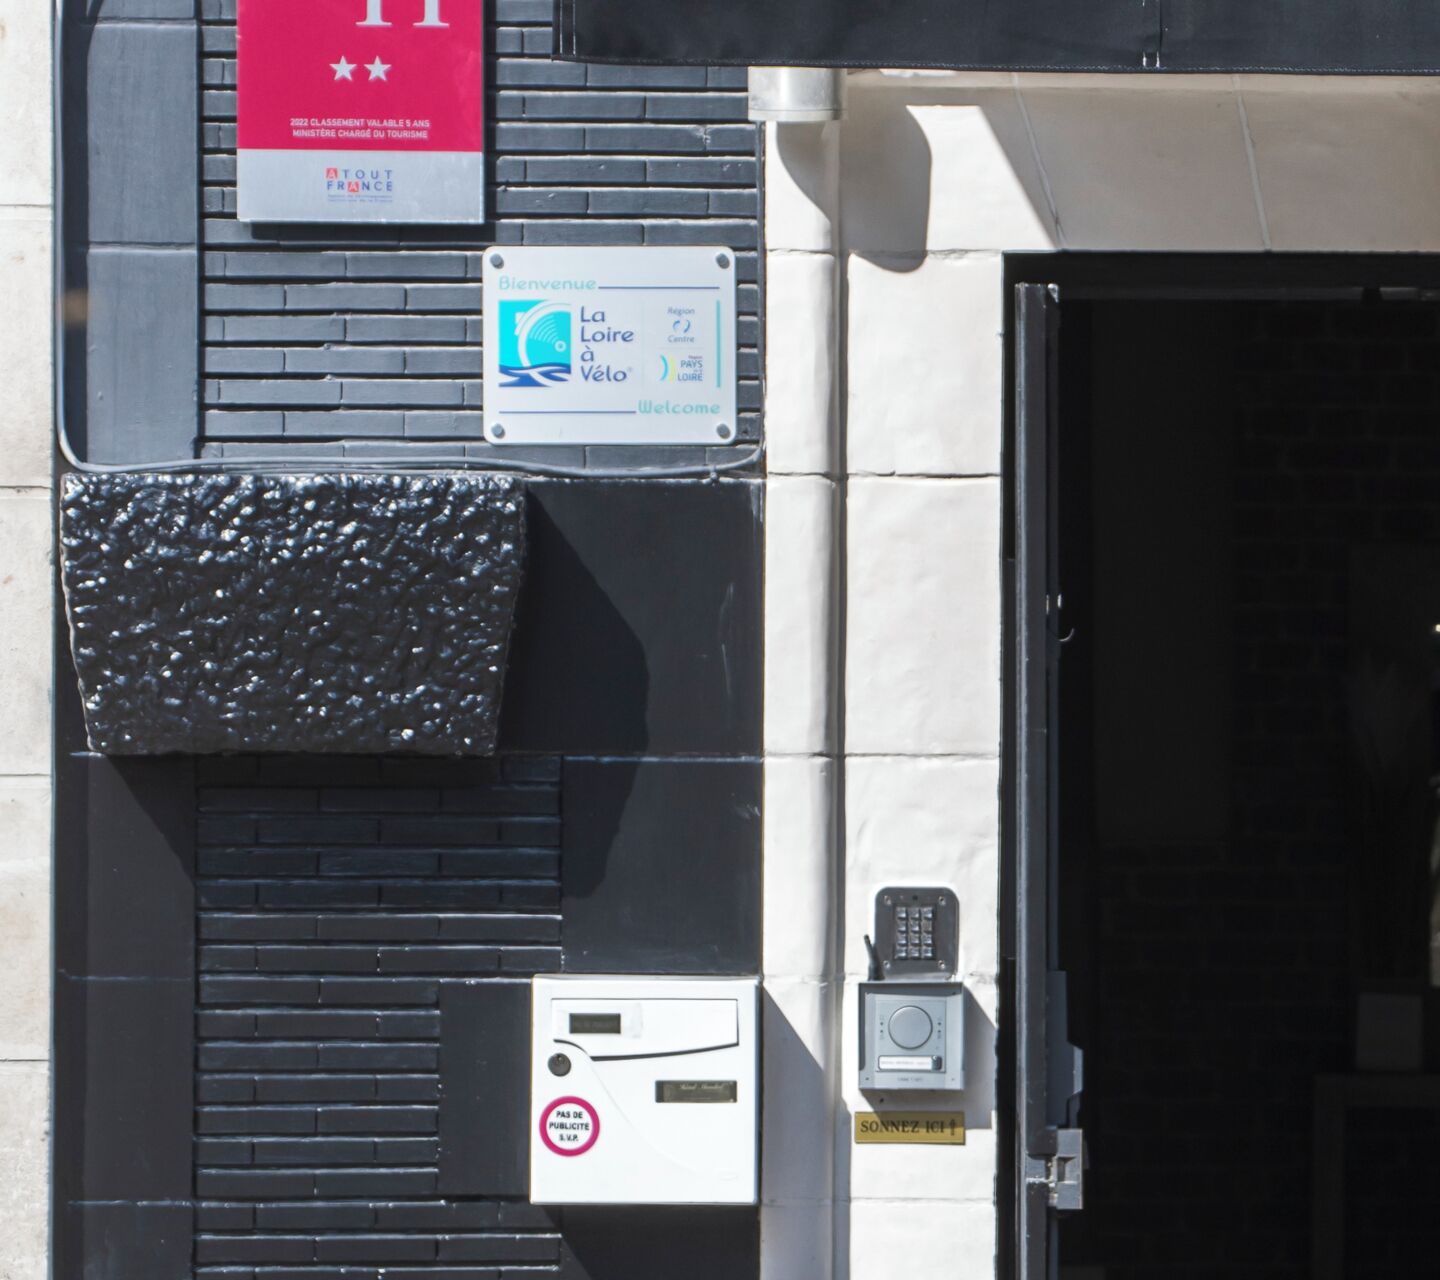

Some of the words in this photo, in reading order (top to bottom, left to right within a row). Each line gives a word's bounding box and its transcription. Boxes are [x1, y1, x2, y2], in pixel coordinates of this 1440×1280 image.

[310, 118, 364, 127] CLASSEMENT
[366, 119, 404, 128] VALABLE
[412, 119, 430, 128] ANS
[292, 128, 336, 138] MINISTÈRE
[338, 128, 371, 138] CHARGÉ
[373, 129, 385, 138] DU
[387, 129, 428, 139] TOURISME
[326, 180, 393, 193] FRANCE
[498, 275, 598, 291] Bienvenue
[580, 305, 606, 323] La
[666, 306, 696, 317] Région
[580, 325, 635, 343] Loire
[667, 334, 695, 344] Centre
[580, 344, 595, 362] à
[680, 359, 704, 369] PAYS
[580, 364, 628, 383] Vélo
[677, 373, 704, 382] LOIRE
[637, 400, 721, 415] Welcome
[556, 1110, 571, 1119] PAS
[572, 1111, 583, 1119] DE
[860, 1120, 920, 1134] SONNEZ
[925, 1120, 944, 1134] ICI
